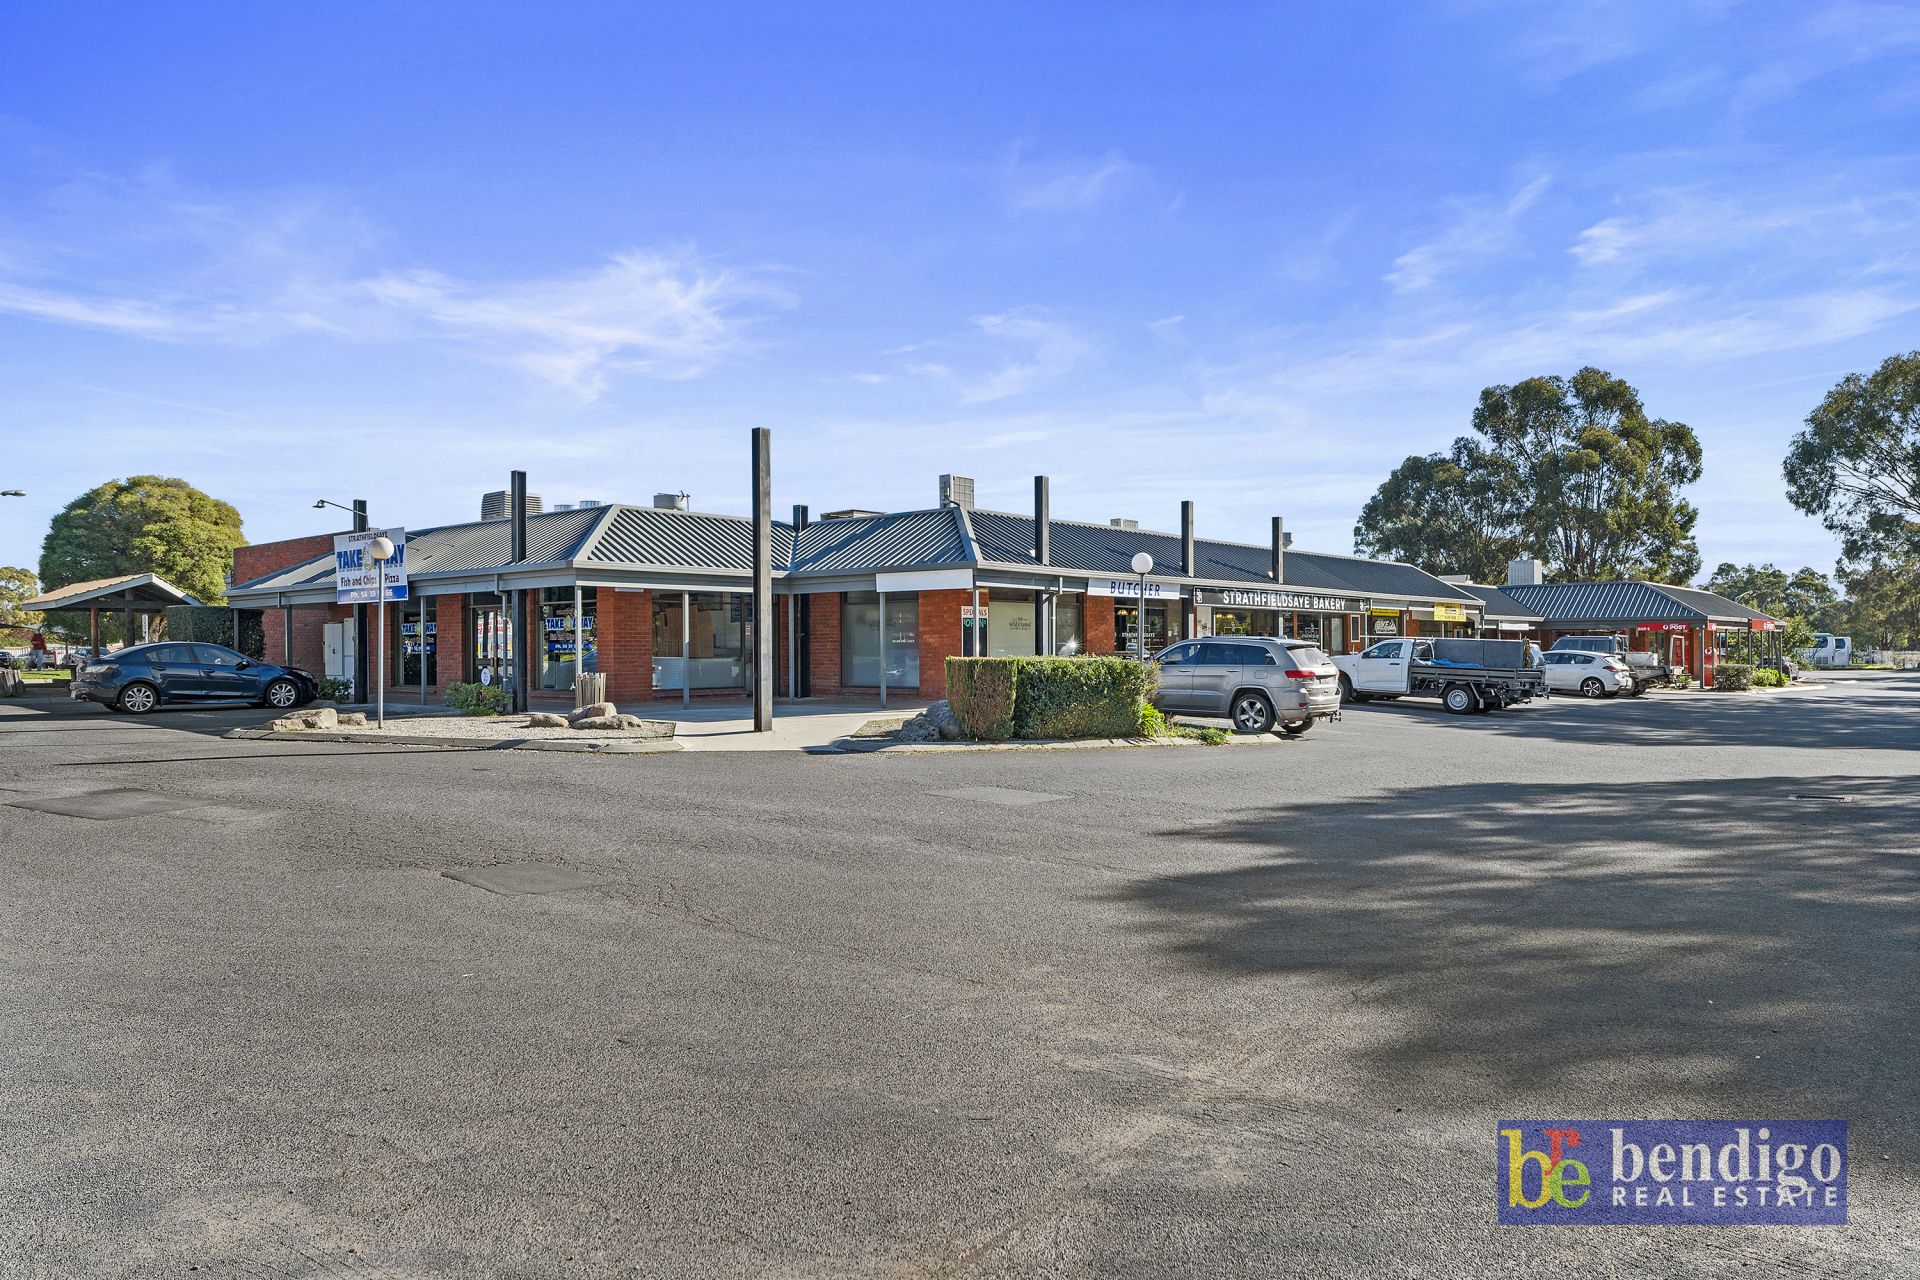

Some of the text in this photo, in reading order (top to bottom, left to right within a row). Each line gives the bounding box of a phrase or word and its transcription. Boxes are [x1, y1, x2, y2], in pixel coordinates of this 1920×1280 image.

[337, 549, 363, 569] TAKE
[341, 577, 351, 587] Fish
[352, 575, 362, 585] and
[384, 573, 400, 583] Pizza
[1223, 591, 1310, 608] STRATHFIELDSAYE
[1313, 597, 1345, 610] BAKERY
[963, 608, 987, 617] SPEALS
[547, 618, 564, 629] TAKE
[965, 618, 984, 628] OPN
